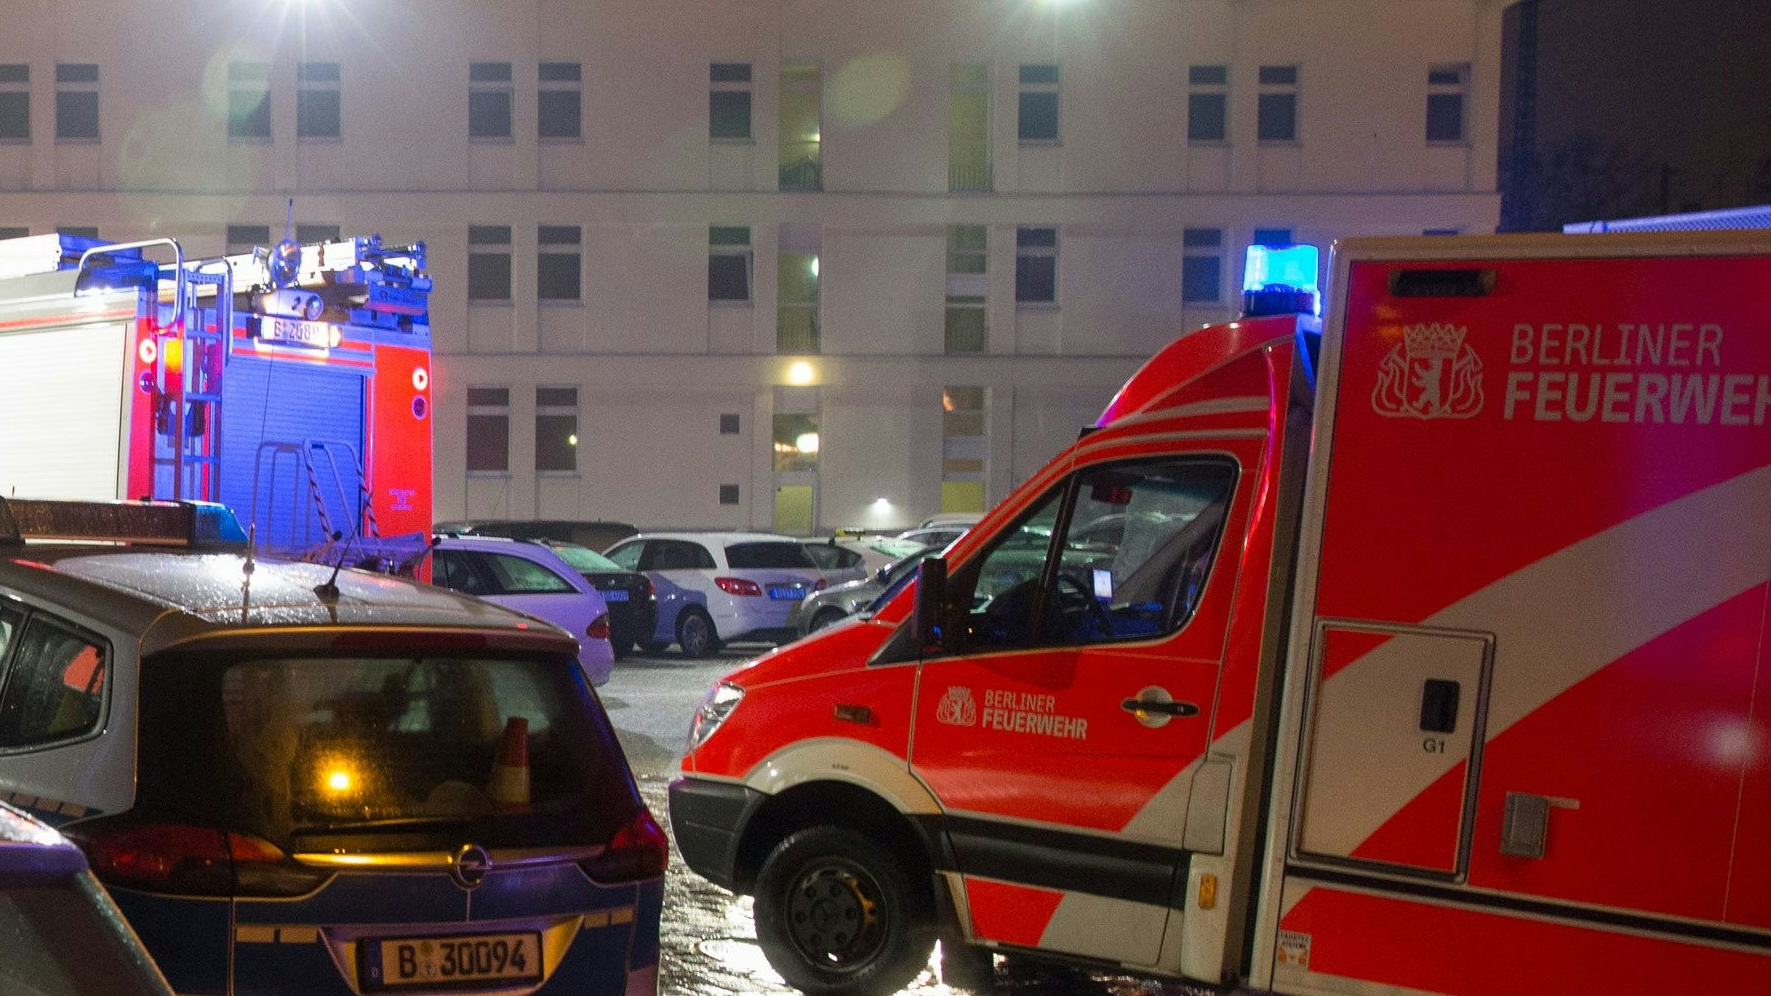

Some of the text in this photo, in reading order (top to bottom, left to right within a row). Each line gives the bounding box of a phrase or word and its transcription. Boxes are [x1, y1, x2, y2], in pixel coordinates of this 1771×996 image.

[1509, 322, 1724, 367] BERLINER
[985, 689, 1056, 713] BERLINER
[982, 707, 1088, 740] FEUERWEHR
[1423, 738, 1445, 753] G1
[398, 944, 418, 979] B
[438, 939, 527, 977] 30094
